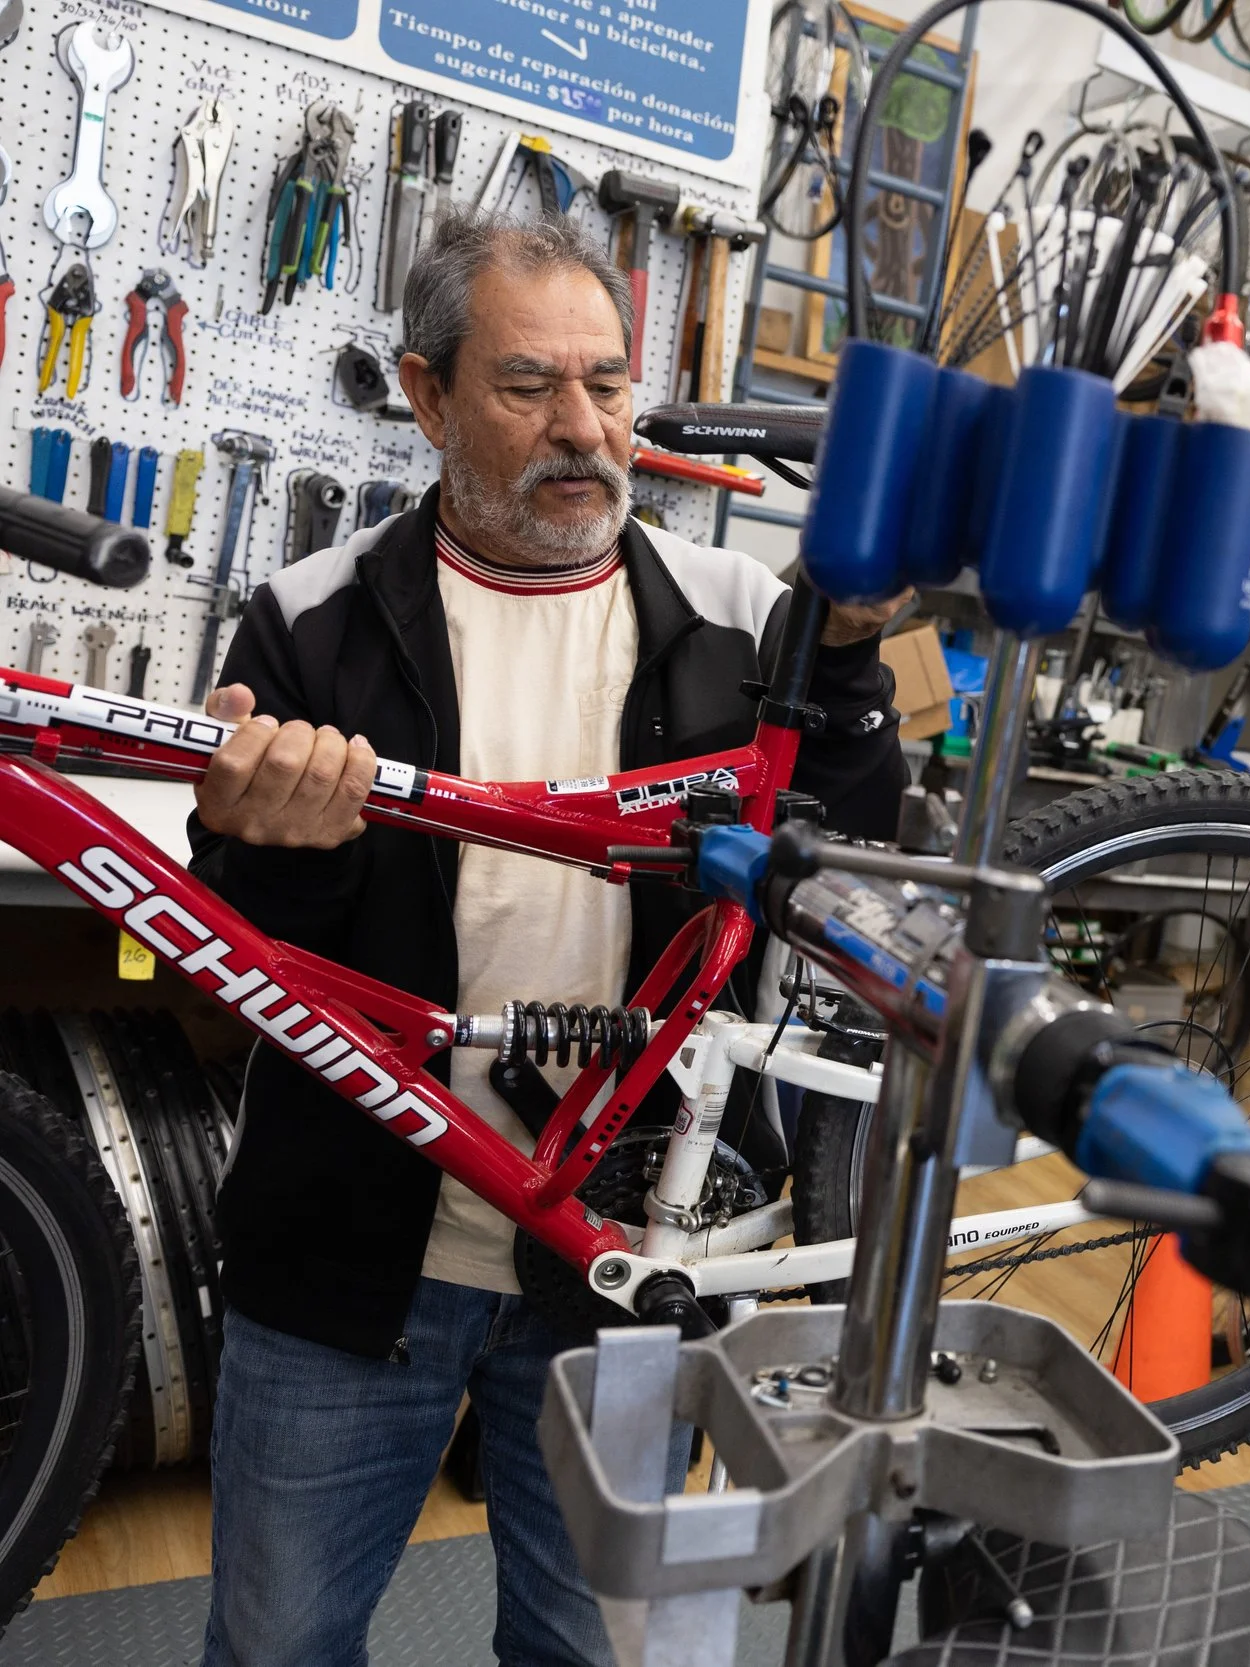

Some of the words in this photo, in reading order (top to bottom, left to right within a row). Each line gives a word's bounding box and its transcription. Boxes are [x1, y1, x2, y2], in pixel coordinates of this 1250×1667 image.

[574, 18, 600, 35] su
[606, 24, 706, 72] bicicleta.
[599, 5, 611, 18] a
[617, 11, 714, 53] aprender
[191, 61, 238, 81] VICE
[388, 8, 482, 52] Tiempo
[487, 39, 515, 63] de
[520, 55, 638, 103] reparación
[642, 90, 736, 135] donación
[433, 51, 541, 96] sugerida:
[607, 103, 645, 129] por
[648, 114, 694, 144] hora
[682, 425, 767, 438] SCHWINN
[6, 596, 60, 613] BRAKE
[57, 845, 450, 1148] SCHWINN
[984, 1221, 1040, 1240] EQUIPPED
